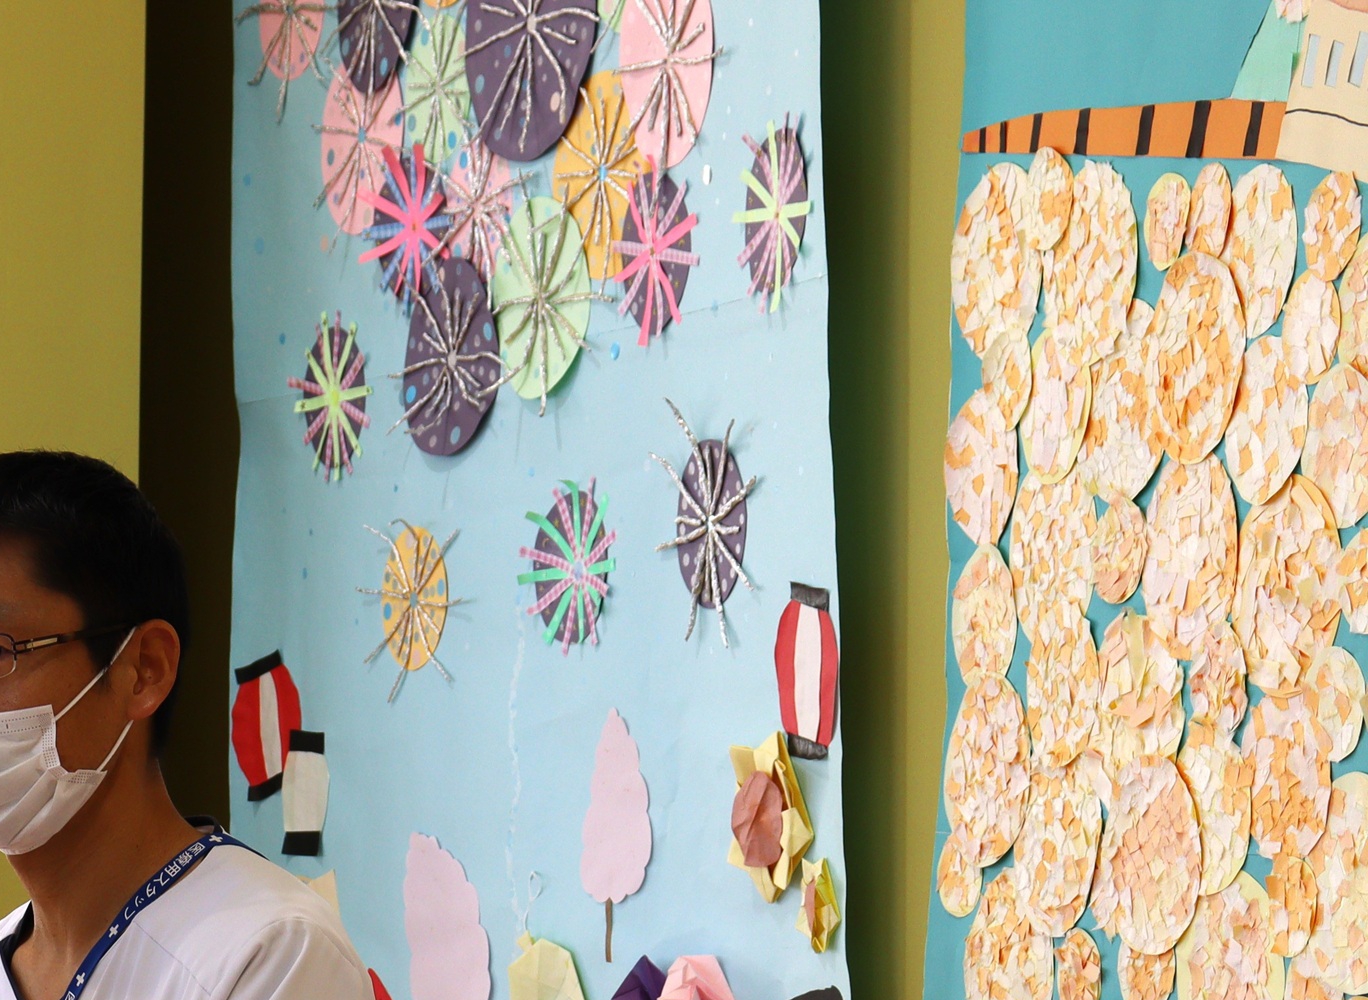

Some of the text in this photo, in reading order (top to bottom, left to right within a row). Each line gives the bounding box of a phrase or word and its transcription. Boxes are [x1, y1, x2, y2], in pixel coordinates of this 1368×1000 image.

[123, 840, 206, 921] 医療用スタッフ
